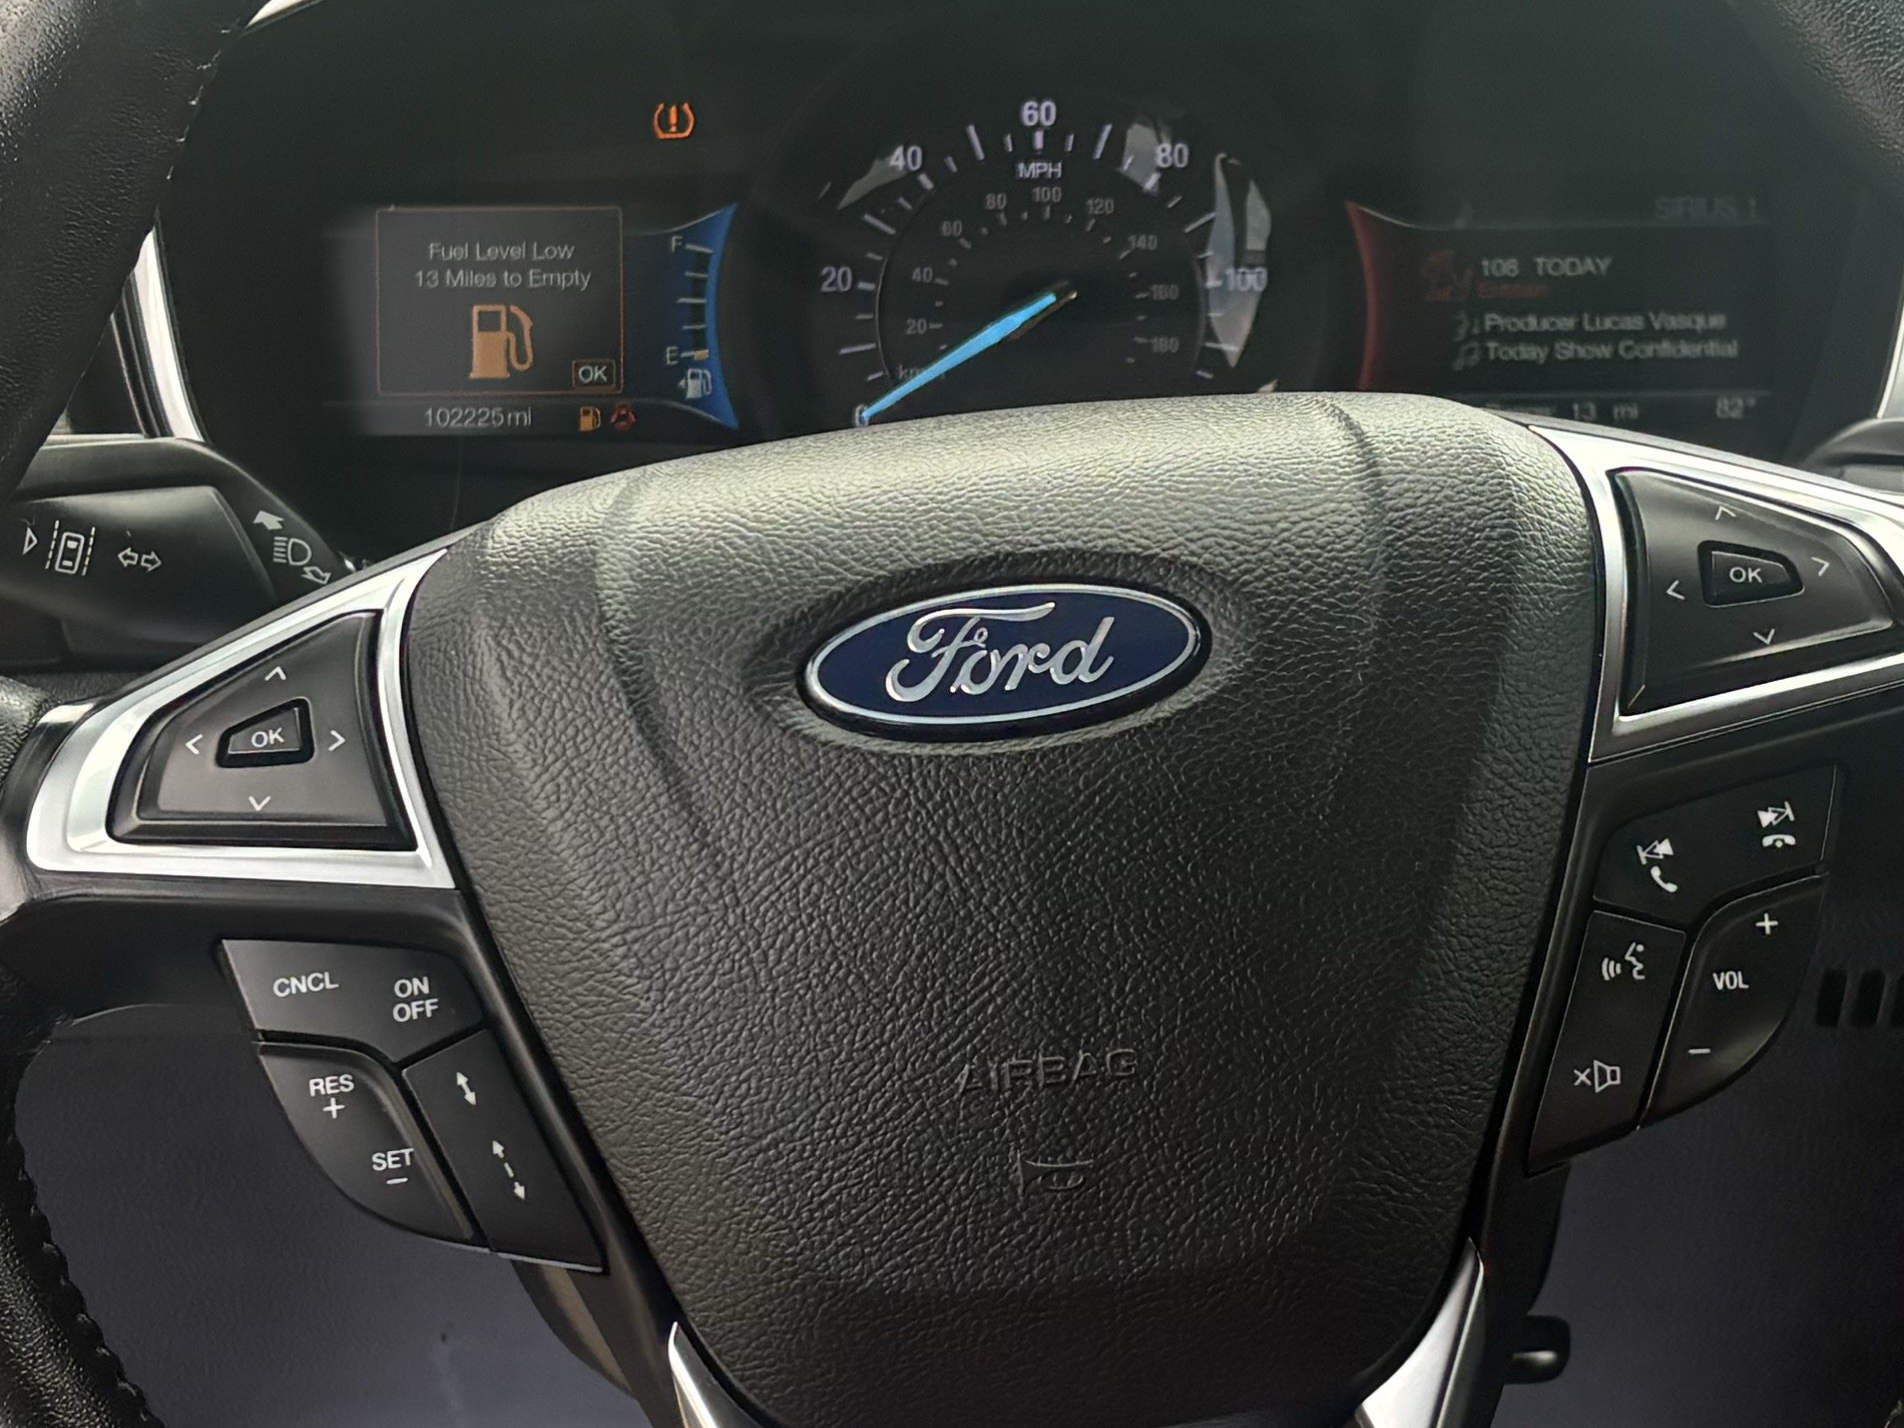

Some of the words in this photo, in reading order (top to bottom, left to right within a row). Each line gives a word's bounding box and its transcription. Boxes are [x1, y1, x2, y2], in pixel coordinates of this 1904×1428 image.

[1022, 101, 1056, 126] 60
[890, 145, 923, 171] 40
[1156, 143, 1189, 168] 80
[1017, 163, 1062, 178] MPH
[985, 193, 1007, 210] 80
[1032, 187, 1062, 203] 100
[1086, 198, 1115, 215] 120
[940, 220, 963, 237] 60
[429, 242, 469, 261] Fuel
[475, 242, 527, 261] Level
[532, 242, 575, 261] Low
[670, 236, 683, 253] F
[1127, 234, 1158, 251] 140
[911, 267, 934, 283] 40
[1481, 257, 1519, 277] 108
[1534, 257, 1612, 277] TODAY
[415, 270, 440, 288] 13
[446, 270, 496, 288] Miles
[503, 270, 523, 288] to
[529, 269, 592, 291] Empty
[820, 266, 853, 292] 20
[1224, 267, 1269, 292] 100
[905, 318, 928, 334] 20
[1484, 312, 1576, 332] Producer
[1582, 312, 1644, 332] Lucas
[1649, 312, 1728, 335] Vasque
[666, 347, 679, 365] E
[1486, 341, 1549, 364] Today
[1554, 341, 1612, 360] Show
[1618, 340, 1739, 360] Confidential
[577, 365, 608, 384] OK
[1571, 402, 1597, 422] 13
[1612, 402, 1639, 421] mi
[1715, 397, 1757, 419] 82°
[1728, 564, 1764, 586] OK
[884, 600, 1116, 703] Ford
[250, 727, 286, 749] OK
[272, 972, 340, 999] CNCL
[392, 976, 430, 1001] ON
[1712, 969, 1751, 992] VOL
[391, 997, 439, 1024] OFF
[955, 1047, 1139, 1096] AIRBAG
[307, 1073, 355, 1098] RES
[370, 1147, 416, 1172] SET
